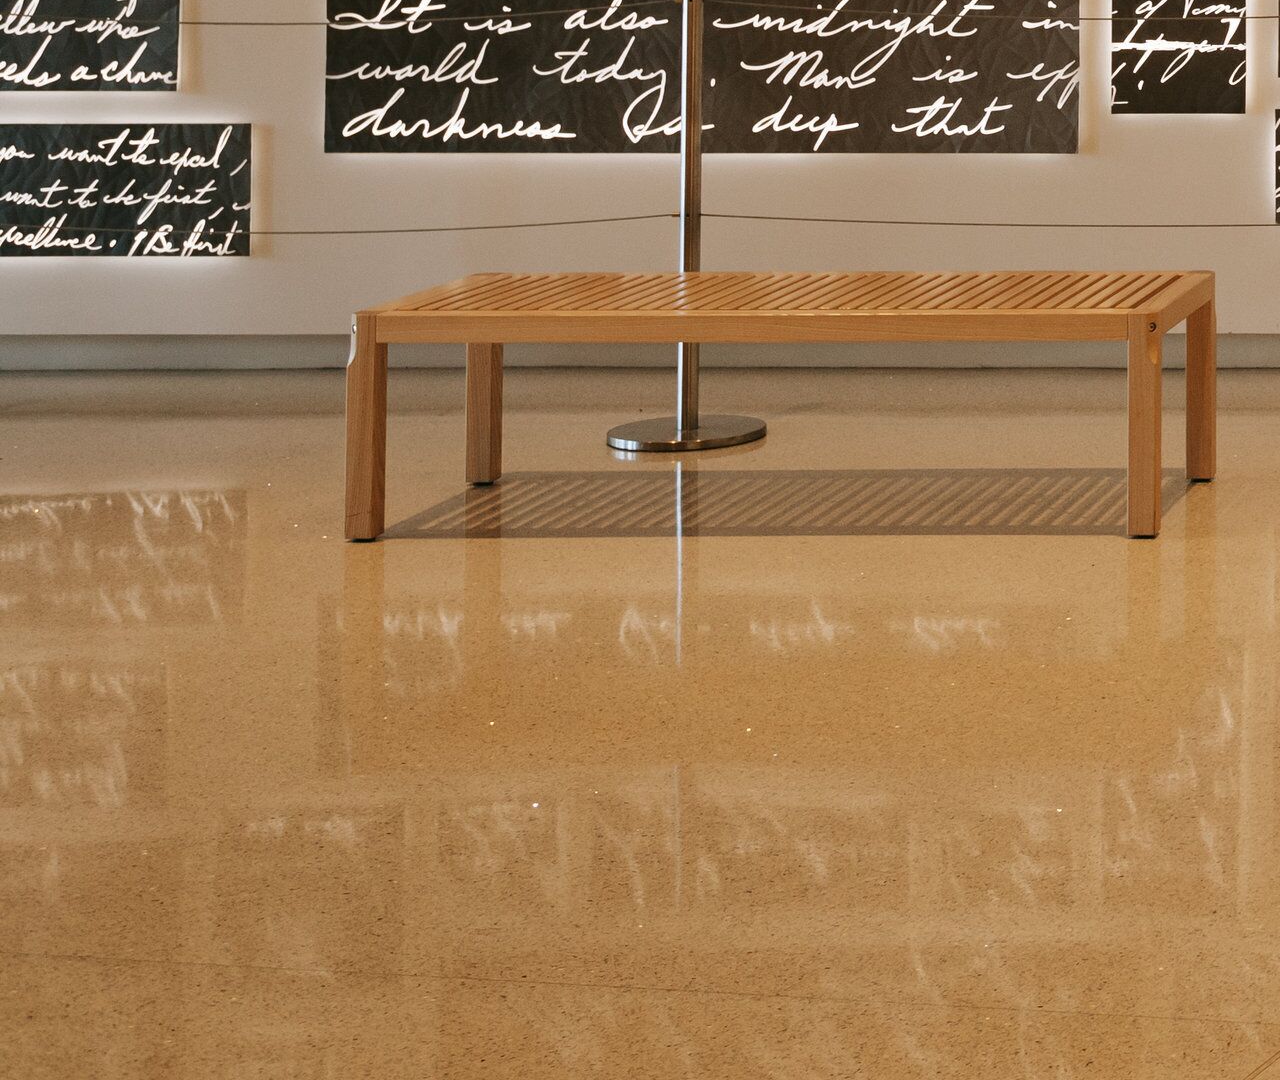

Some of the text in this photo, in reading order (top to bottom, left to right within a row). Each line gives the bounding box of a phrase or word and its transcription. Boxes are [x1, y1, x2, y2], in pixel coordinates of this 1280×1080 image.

[463, 5, 532, 34] is
[70, 61, 98, 81] a
[326, 38, 978, 89] world Man is
[342, 87, 1013, 151] darkness deep that
[67, 179, 100, 209] to
